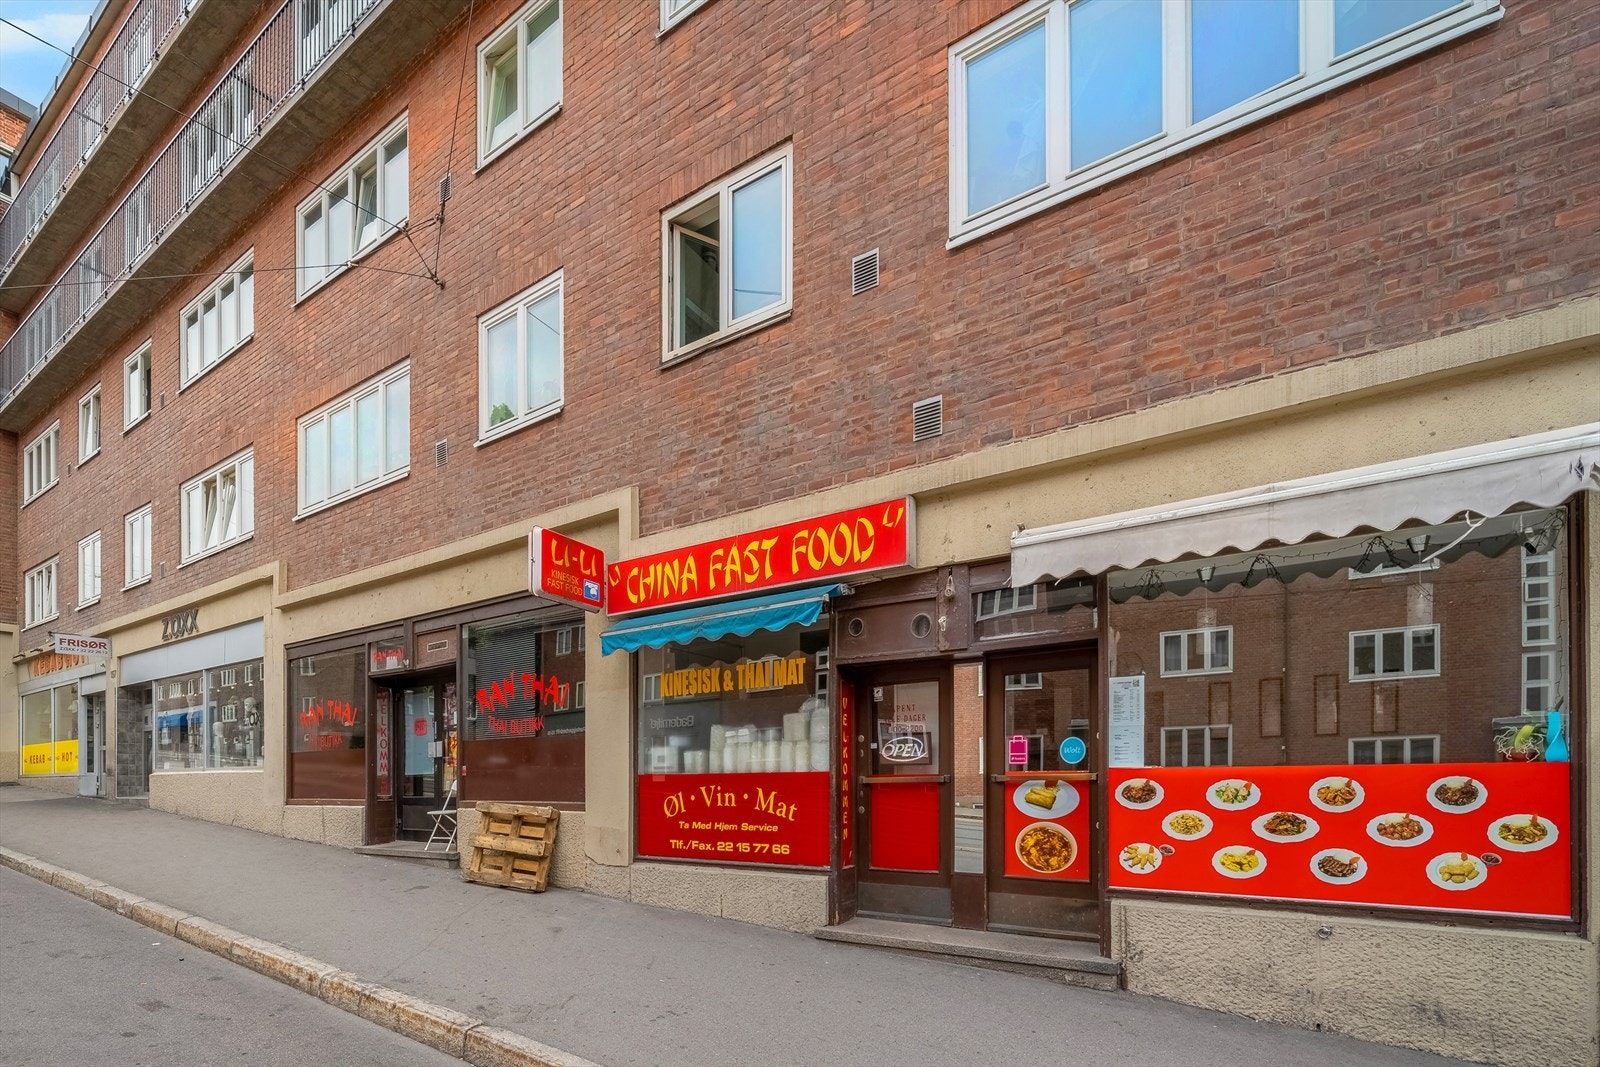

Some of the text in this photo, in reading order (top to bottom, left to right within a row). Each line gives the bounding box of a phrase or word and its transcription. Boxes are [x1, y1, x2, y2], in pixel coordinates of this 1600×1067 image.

[551, 538, 597, 577] LI-LI
[627, 517, 875, 604] CHINA FAST FOOD
[551, 569, 580, 585] KINESISK
[547, 577, 564, 590] FAST
[565, 583, 583, 596] FOOD
[59, 638, 107, 650] FRISØR
[32, 654, 63, 677] KEBAB
[660, 657, 806, 698] KINESISK & THAI MAT
[476, 670, 515, 714] RAN
[521, 673, 569, 708] THAI
[903, 714, 926, 722] DAGER
[29, 752, 72, 764] KEBAB HOT
[882, 743, 922, 757] OPEN
[1064, 746, 1081, 754] Wolt
[663, 785, 797, 821] Øl Vin Mat
[679, 821, 778, 832] Ta Med Hjem Service
[670, 839, 790, 854] Tlf./Fax. 22 15 77 66
